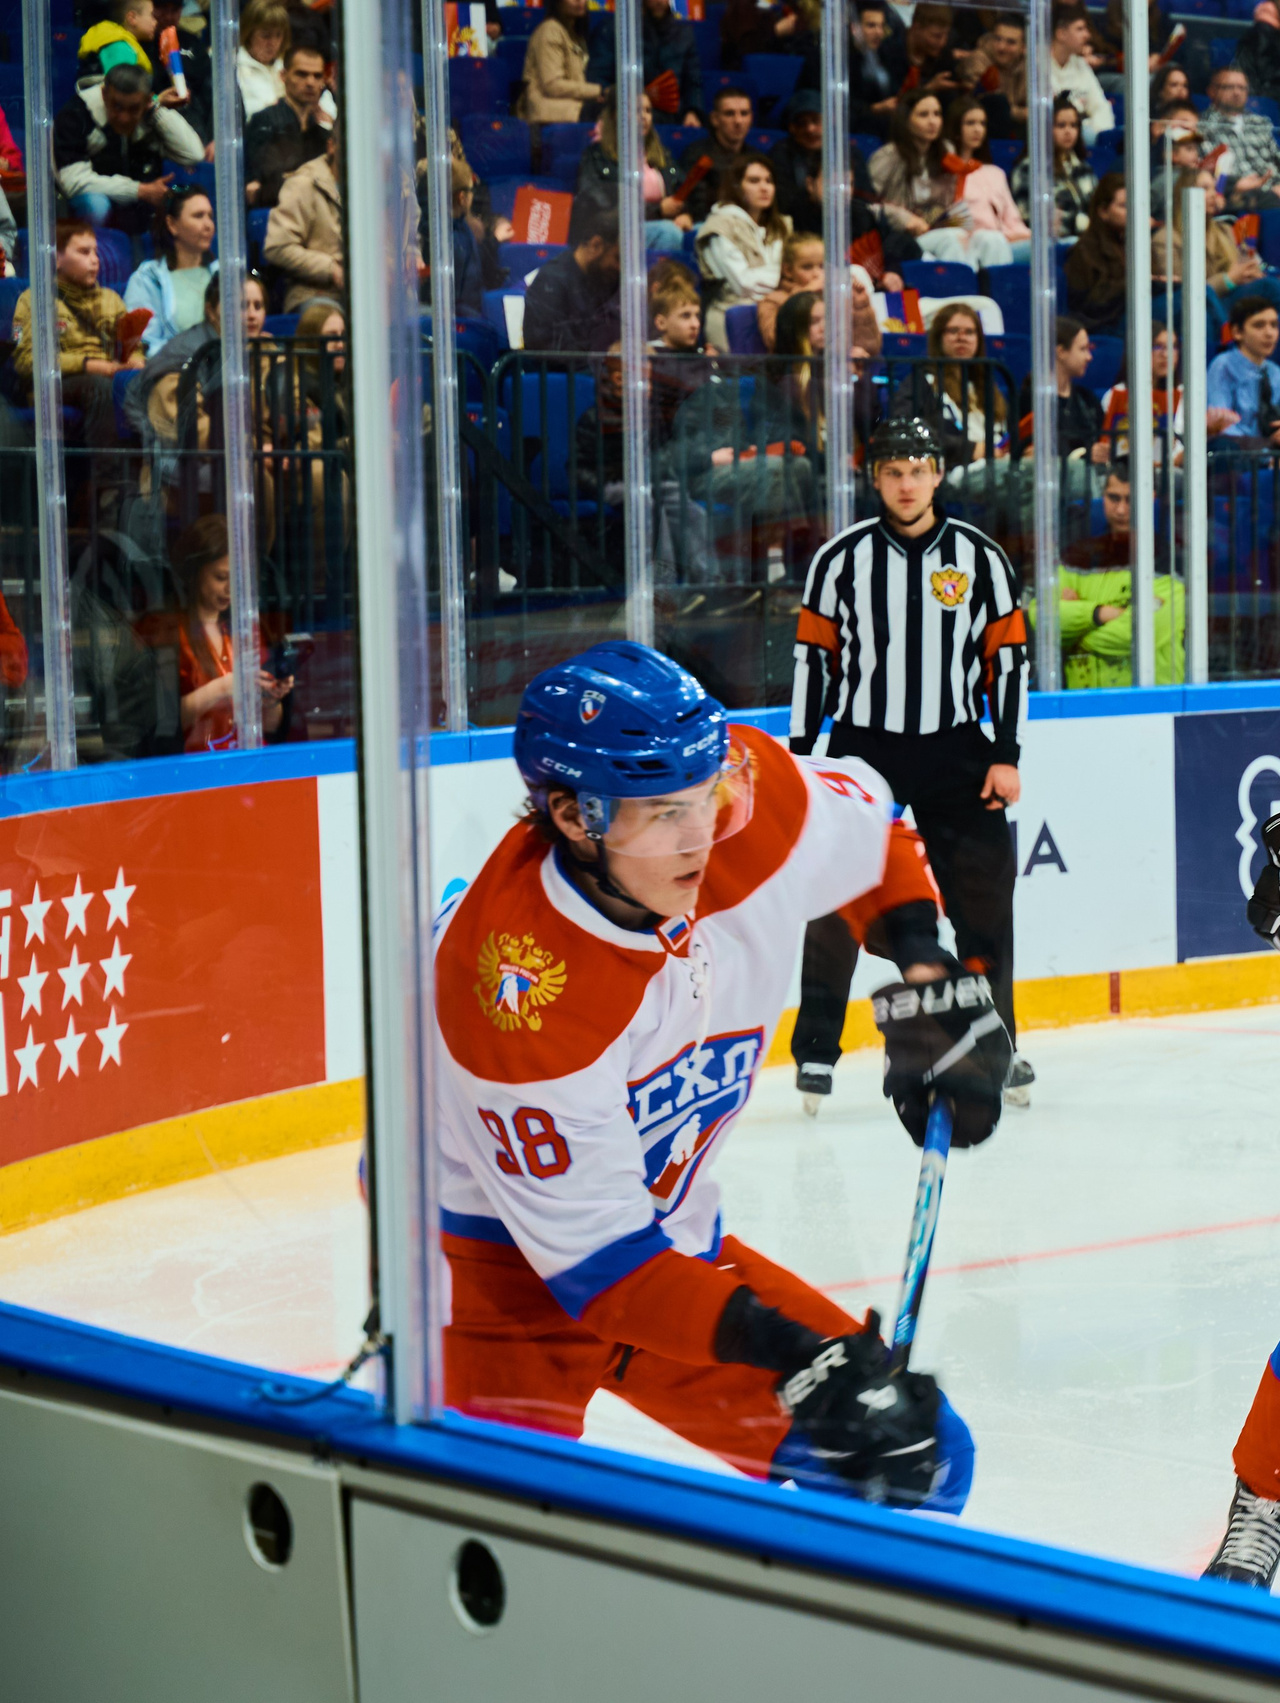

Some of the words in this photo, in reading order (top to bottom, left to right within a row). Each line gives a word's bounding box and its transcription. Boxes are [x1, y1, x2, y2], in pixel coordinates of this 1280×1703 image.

[541, 757, 584, 778] CCM
[682, 729, 719, 758] CCM
[634, 1038, 760, 1126] СХЛ
[477, 1106, 573, 1181] 98
